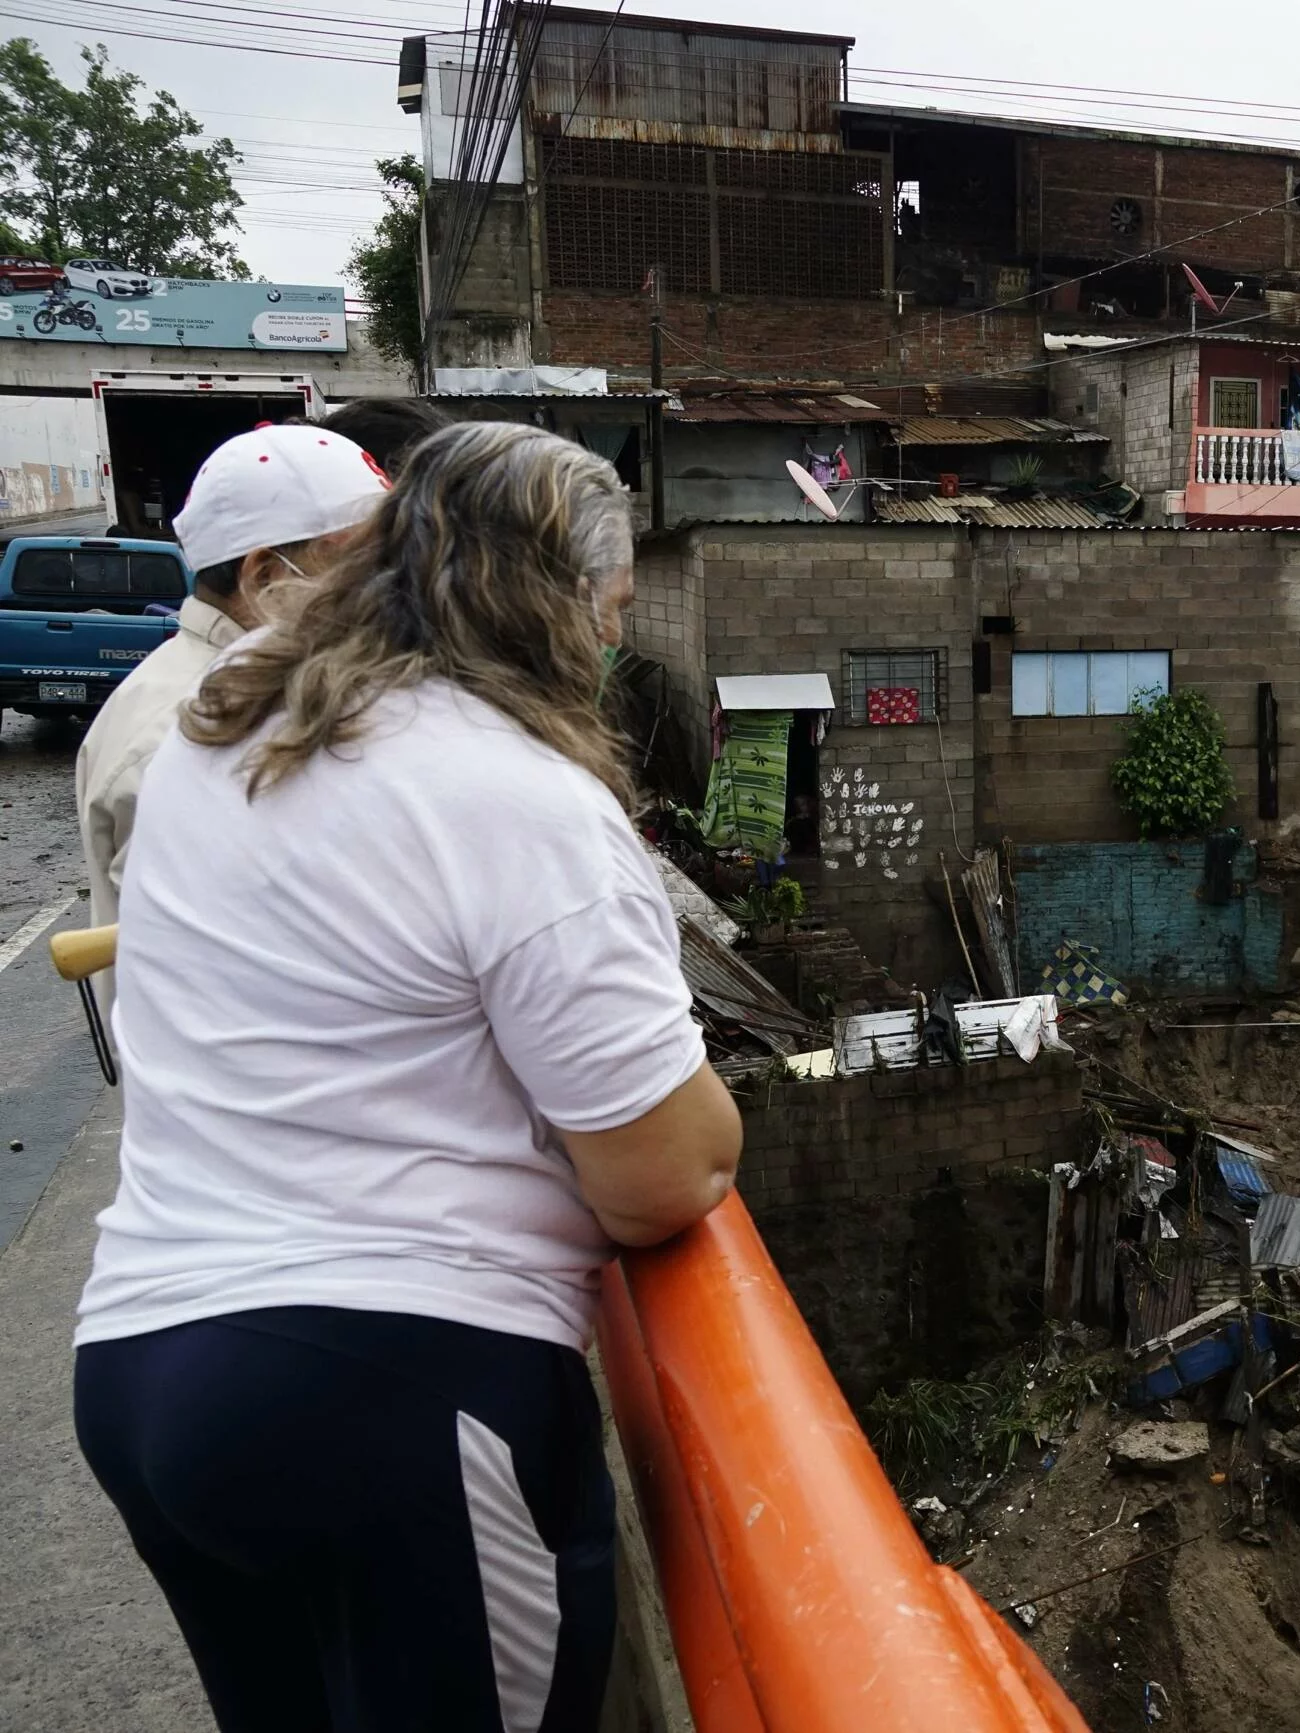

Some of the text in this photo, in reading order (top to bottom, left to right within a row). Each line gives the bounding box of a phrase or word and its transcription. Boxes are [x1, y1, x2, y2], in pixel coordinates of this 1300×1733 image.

[154, 280, 168, 296] 2
[115, 309, 151, 331] 25
[99, 649, 152, 660] mazd
[21, 668, 64, 676] TOYO
